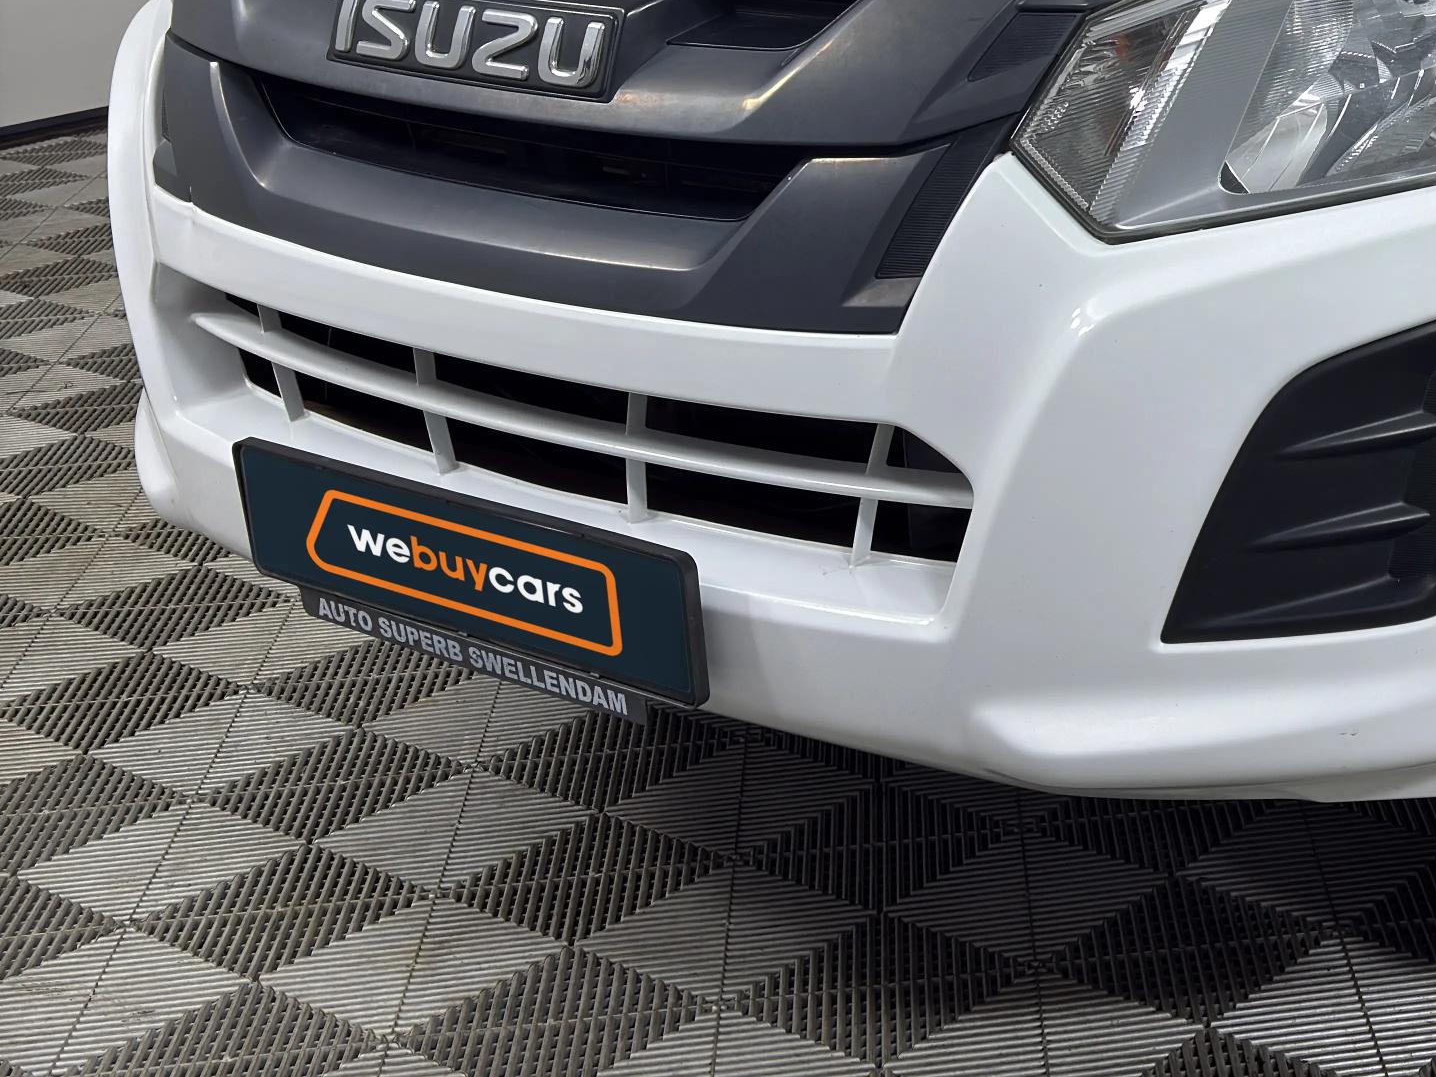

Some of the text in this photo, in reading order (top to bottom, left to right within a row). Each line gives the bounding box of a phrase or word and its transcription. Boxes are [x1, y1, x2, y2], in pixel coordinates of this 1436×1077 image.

[347, 524, 584, 615] webuycars
[318, 597, 629, 716] AUTO SUPERB SWELLENDAM
